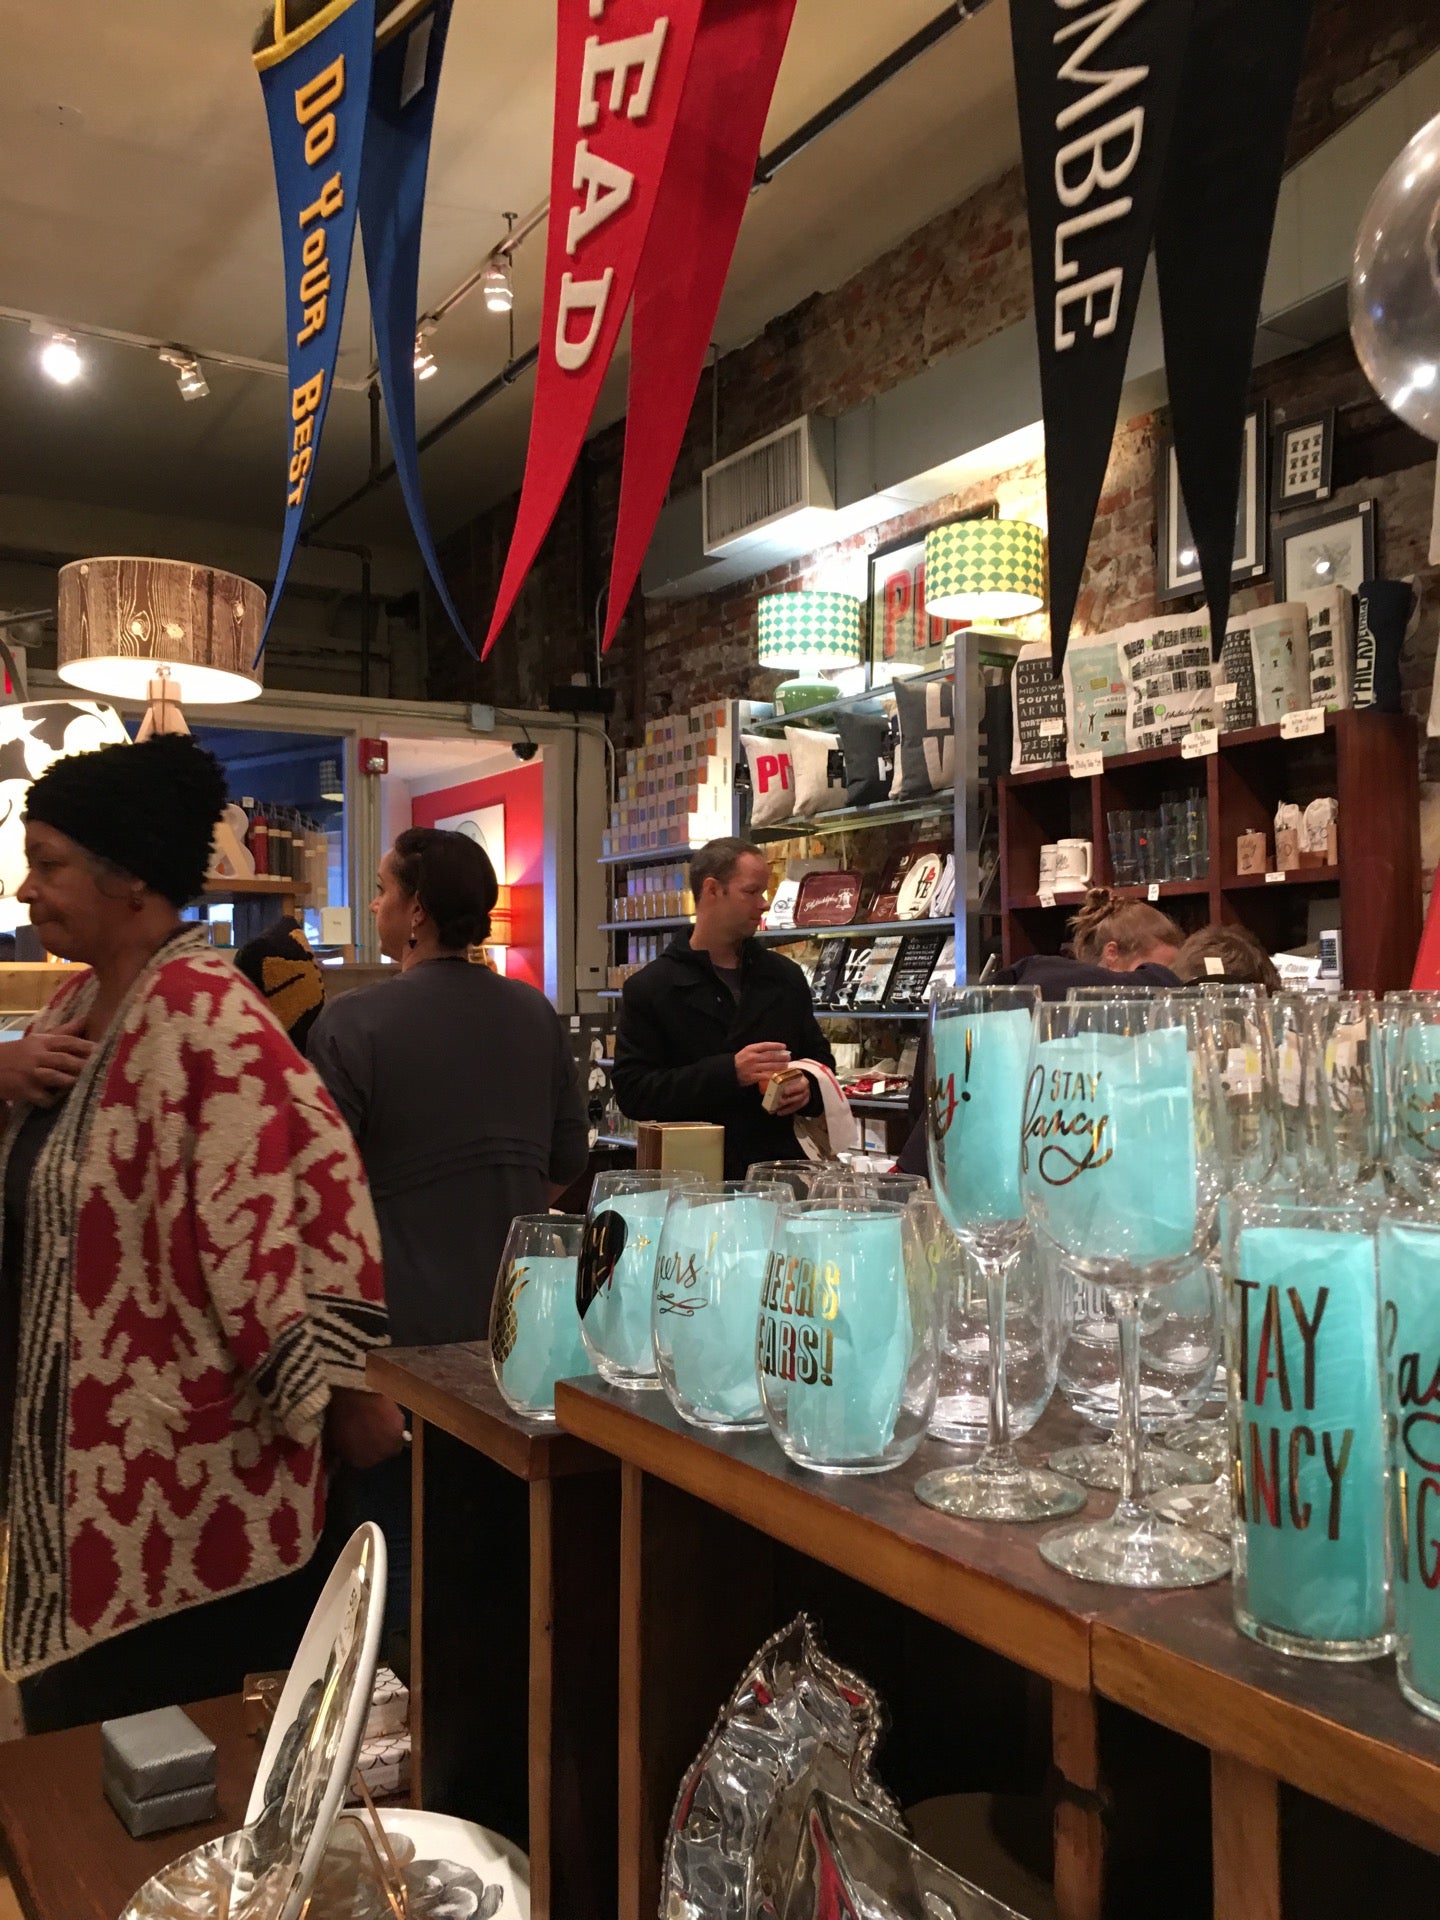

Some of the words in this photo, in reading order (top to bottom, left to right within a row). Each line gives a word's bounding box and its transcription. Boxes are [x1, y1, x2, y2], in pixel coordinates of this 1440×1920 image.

[555, 0, 669, 370] EAD
[1053, 0, 1150, 352] MBLE
[1019, 661, 1053, 673] RITTE
[1019, 672, 1053, 685] OLD
[1018, 693, 1058, 705] SOUTH
[1050, 1070, 1103, 1102] STAY
[1022, 1064, 1113, 1186] fancy
[655, 1231, 720, 1291] eers!
[1234, 1279, 1330, 1412] TAY
